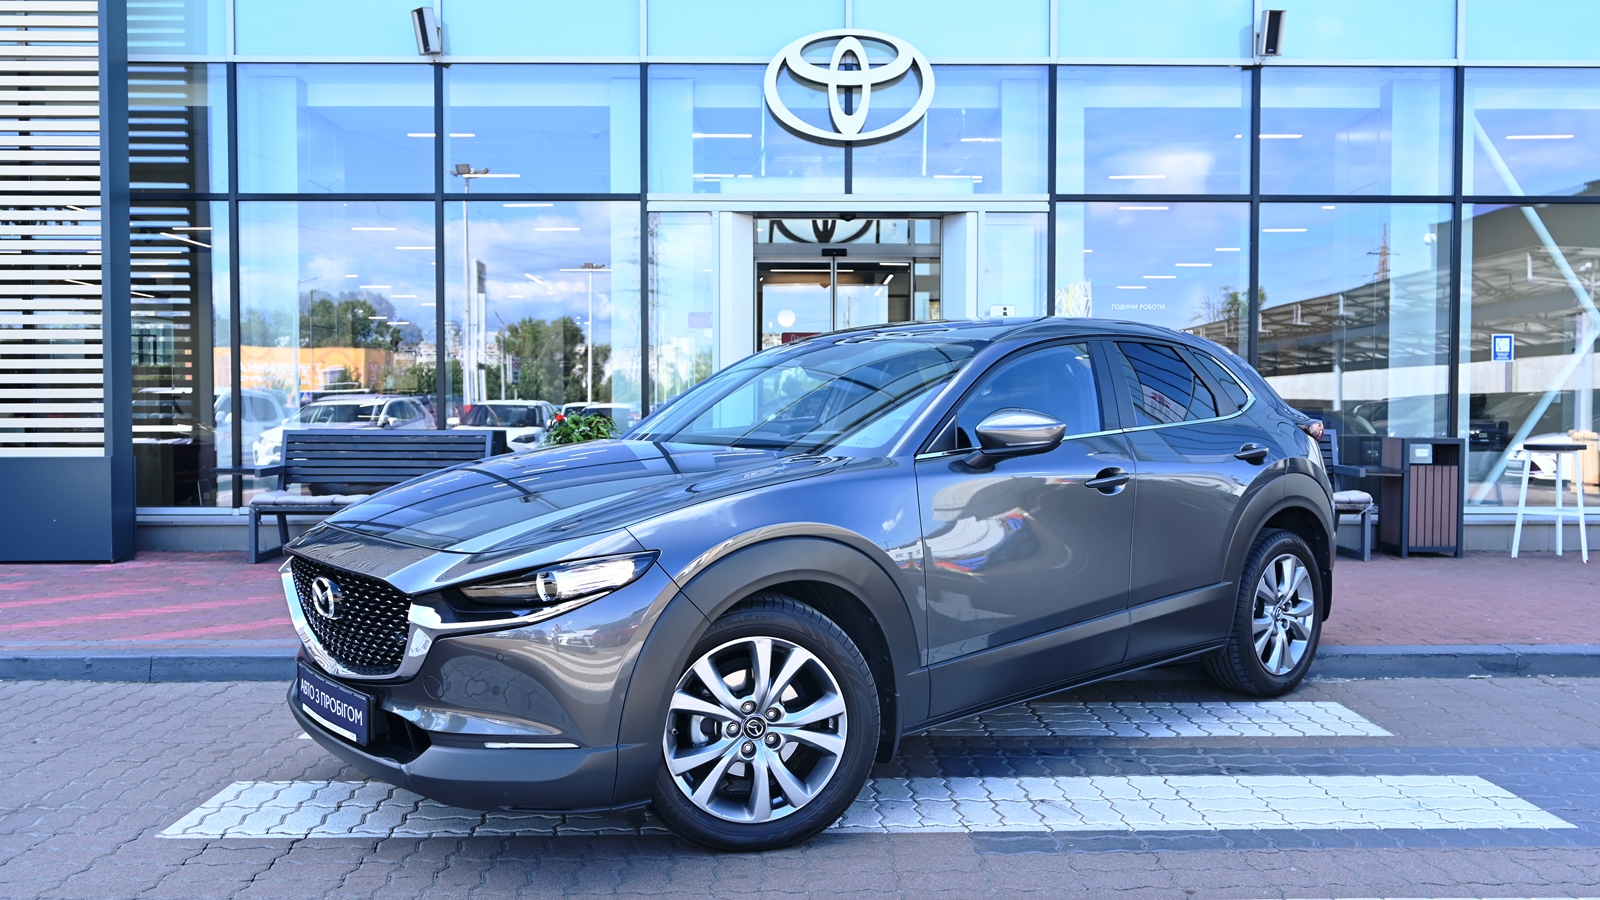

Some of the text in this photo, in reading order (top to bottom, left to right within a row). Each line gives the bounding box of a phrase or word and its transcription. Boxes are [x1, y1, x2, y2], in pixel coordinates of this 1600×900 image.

[1111, 303, 1139, 311] ГОДИНИ
[724, 614, 754, 626] BLUE
[300, 678, 315, 700] АВТО
[320, 691, 363, 726] ПРОБІГОМ
